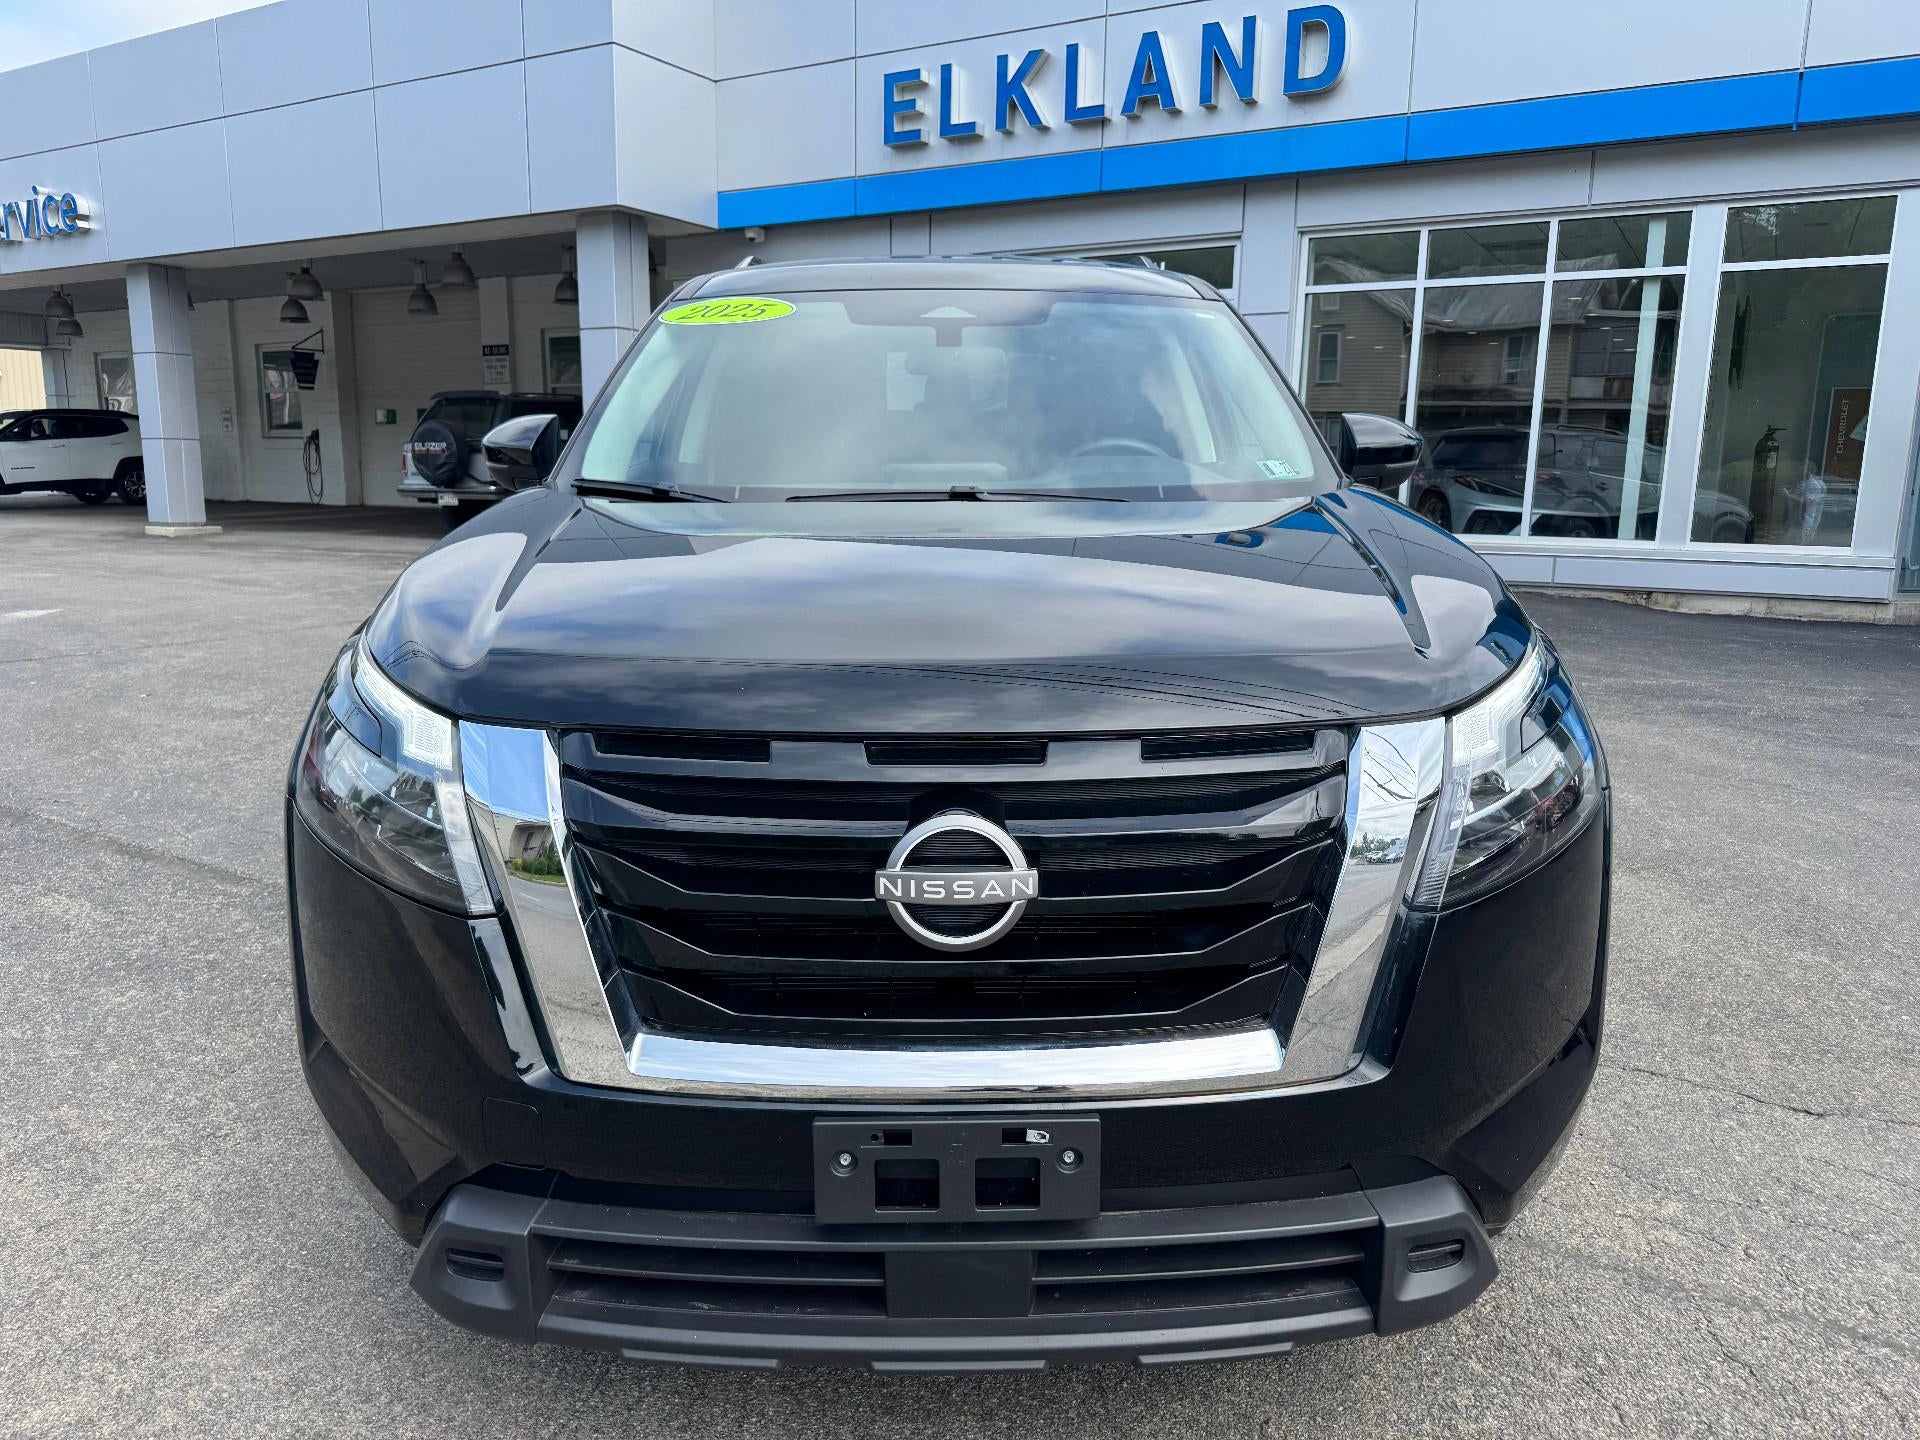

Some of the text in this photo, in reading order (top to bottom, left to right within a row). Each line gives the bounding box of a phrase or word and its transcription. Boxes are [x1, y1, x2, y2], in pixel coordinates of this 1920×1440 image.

[883, 4, 1346, 147] ELKLAND
[0, 185, 79, 240] rvice
[676, 303, 779, 321] 2025
[1836, 399, 1849, 454] CHEVROLET
[879, 876, 1033, 899] NISSAN
